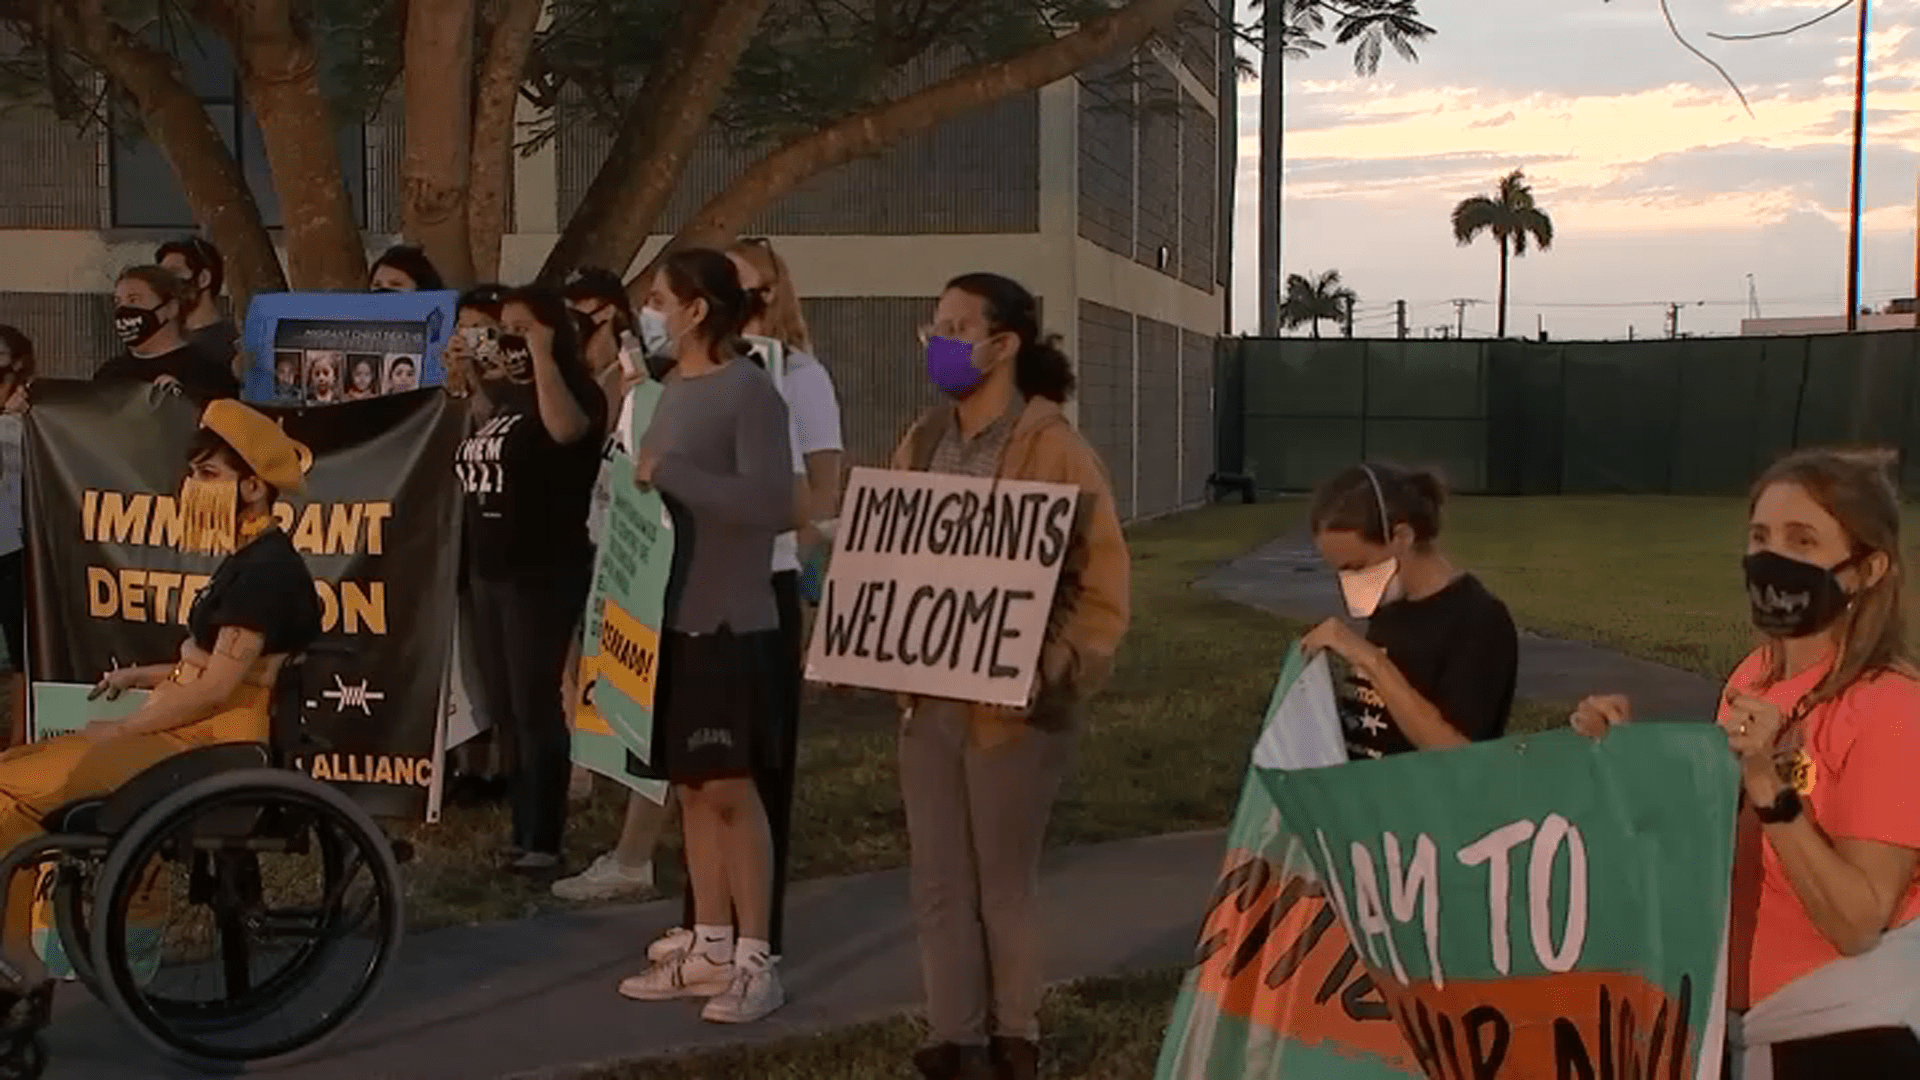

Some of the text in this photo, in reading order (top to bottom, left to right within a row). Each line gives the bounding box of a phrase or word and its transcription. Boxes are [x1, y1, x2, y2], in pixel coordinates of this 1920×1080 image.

[845, 486, 1071, 567] IMMIGRANTS
[824, 579, 1035, 679] WELCOME
[311, 753, 433, 787] ALLIANC
[1457, 813, 1588, 976] TO
